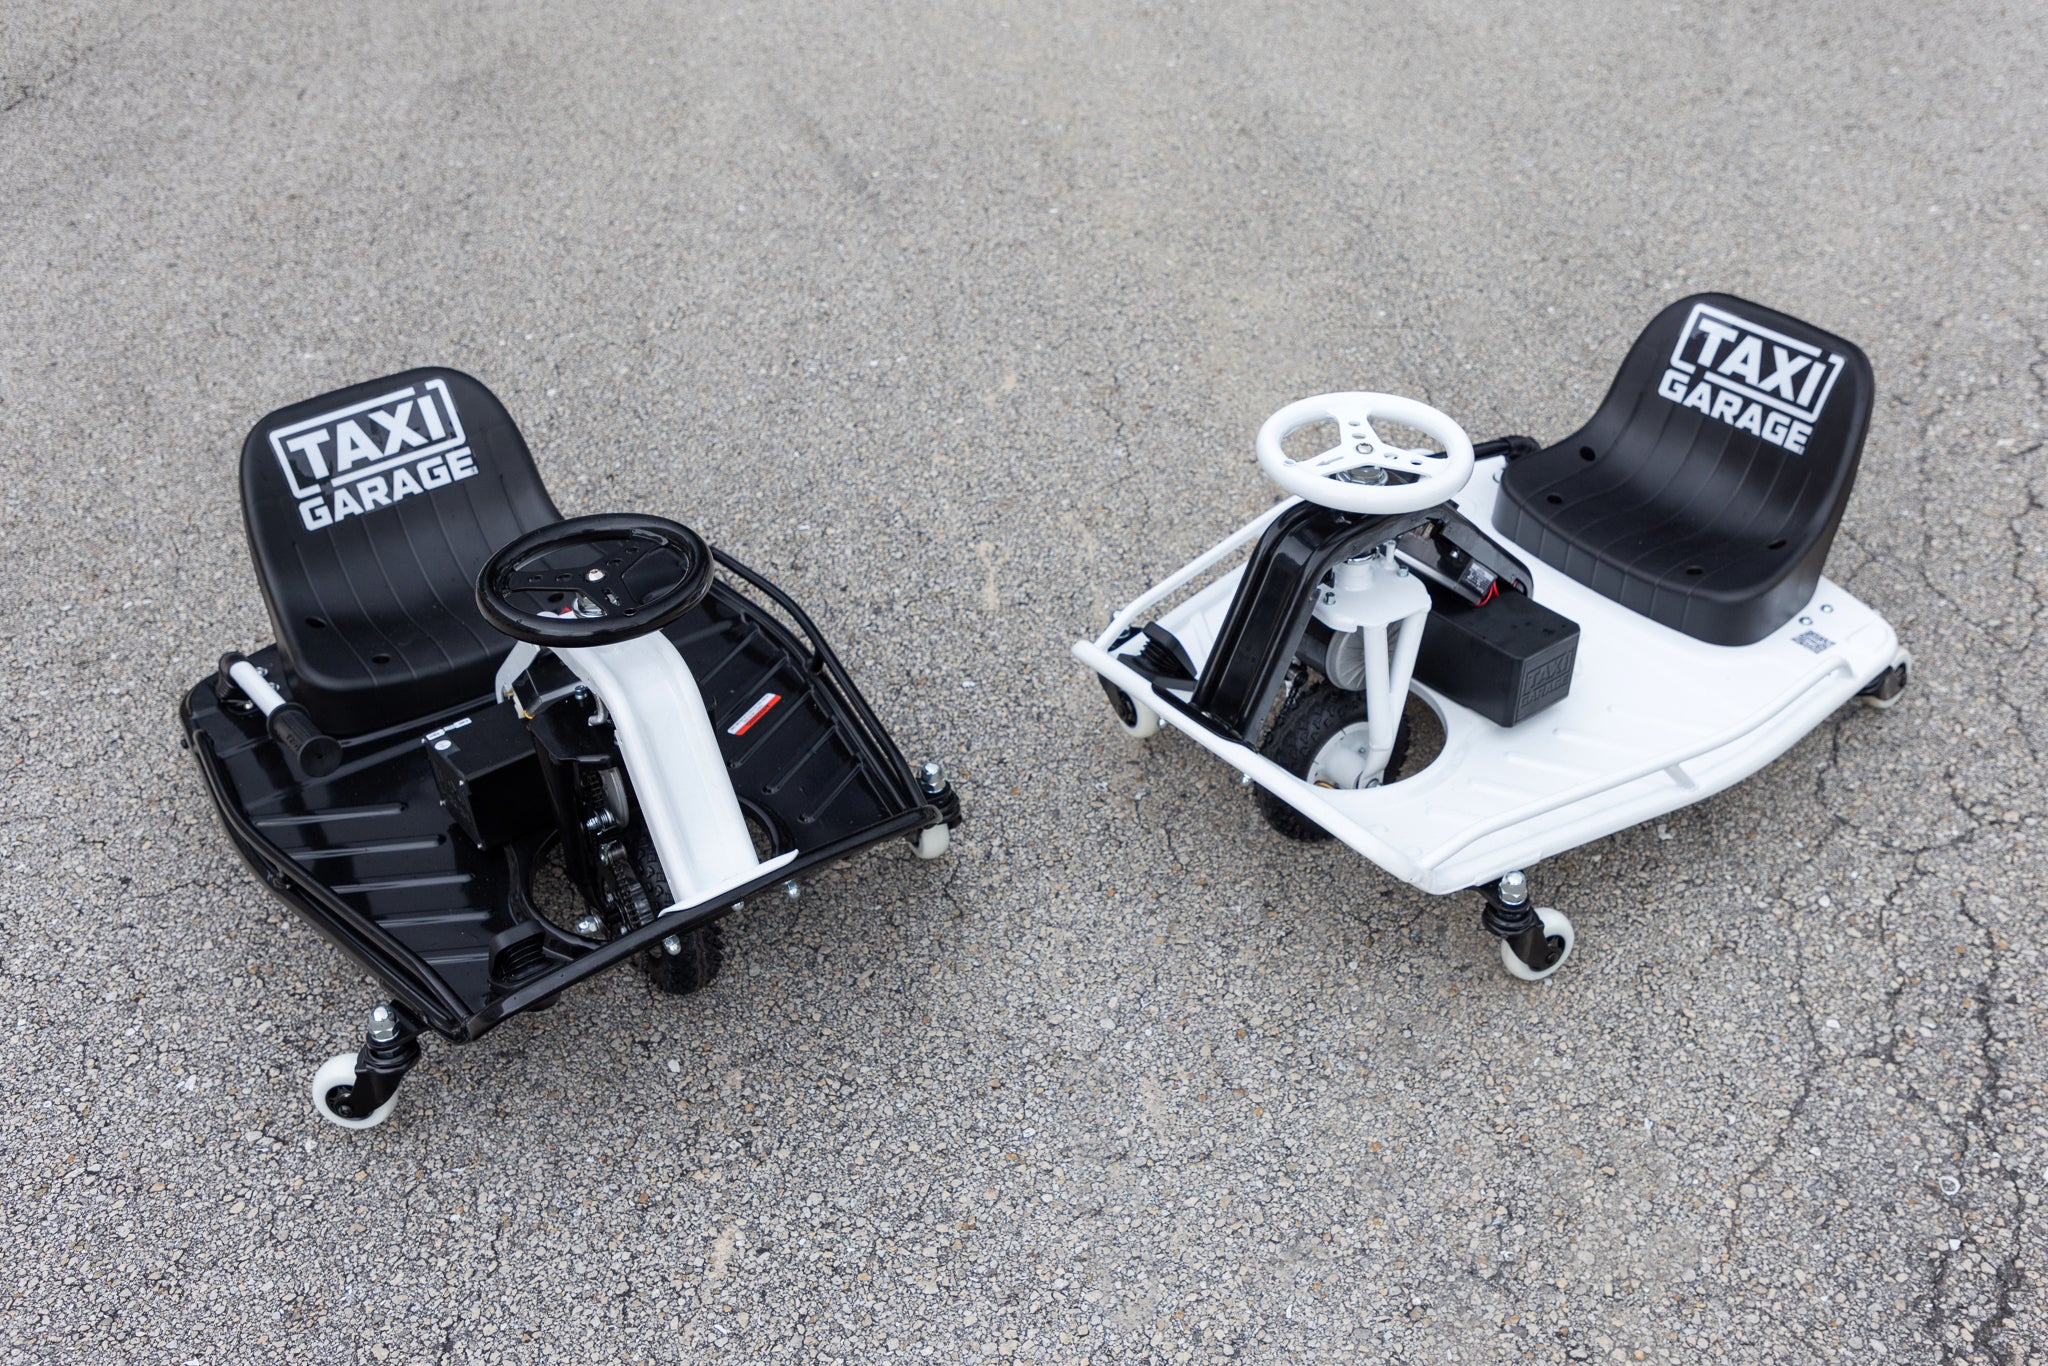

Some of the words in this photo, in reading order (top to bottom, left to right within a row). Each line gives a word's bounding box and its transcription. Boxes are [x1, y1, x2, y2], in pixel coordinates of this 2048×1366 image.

[1697, 318, 1827, 407] TAXI
[286, 395, 446, 480] TAXI
[1658, 368, 1814, 455] GARAGE
[299, 446, 479, 531] GARAGE
[1520, 674, 1570, 708] GARAGE
[1527, 652, 1569, 689] TAXI
